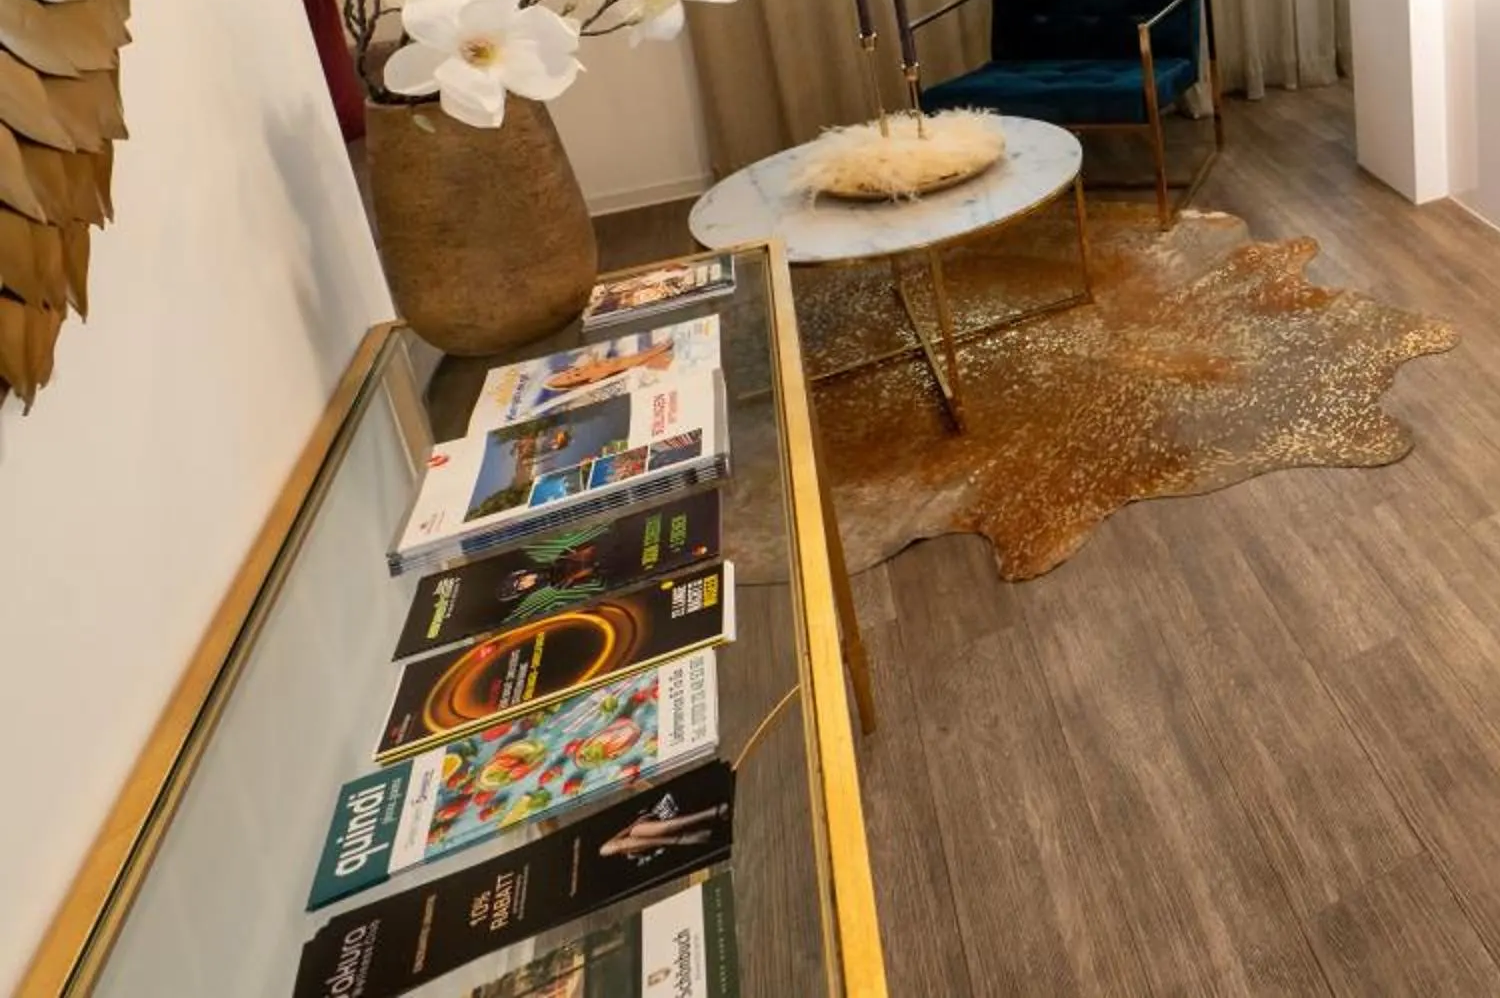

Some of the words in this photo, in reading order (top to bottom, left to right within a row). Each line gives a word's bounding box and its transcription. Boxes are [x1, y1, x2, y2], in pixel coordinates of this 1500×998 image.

[335, 783, 389, 876] quindi
[470, 890, 491, 927] 10%
[490, 871, 514, 930] RABATT
